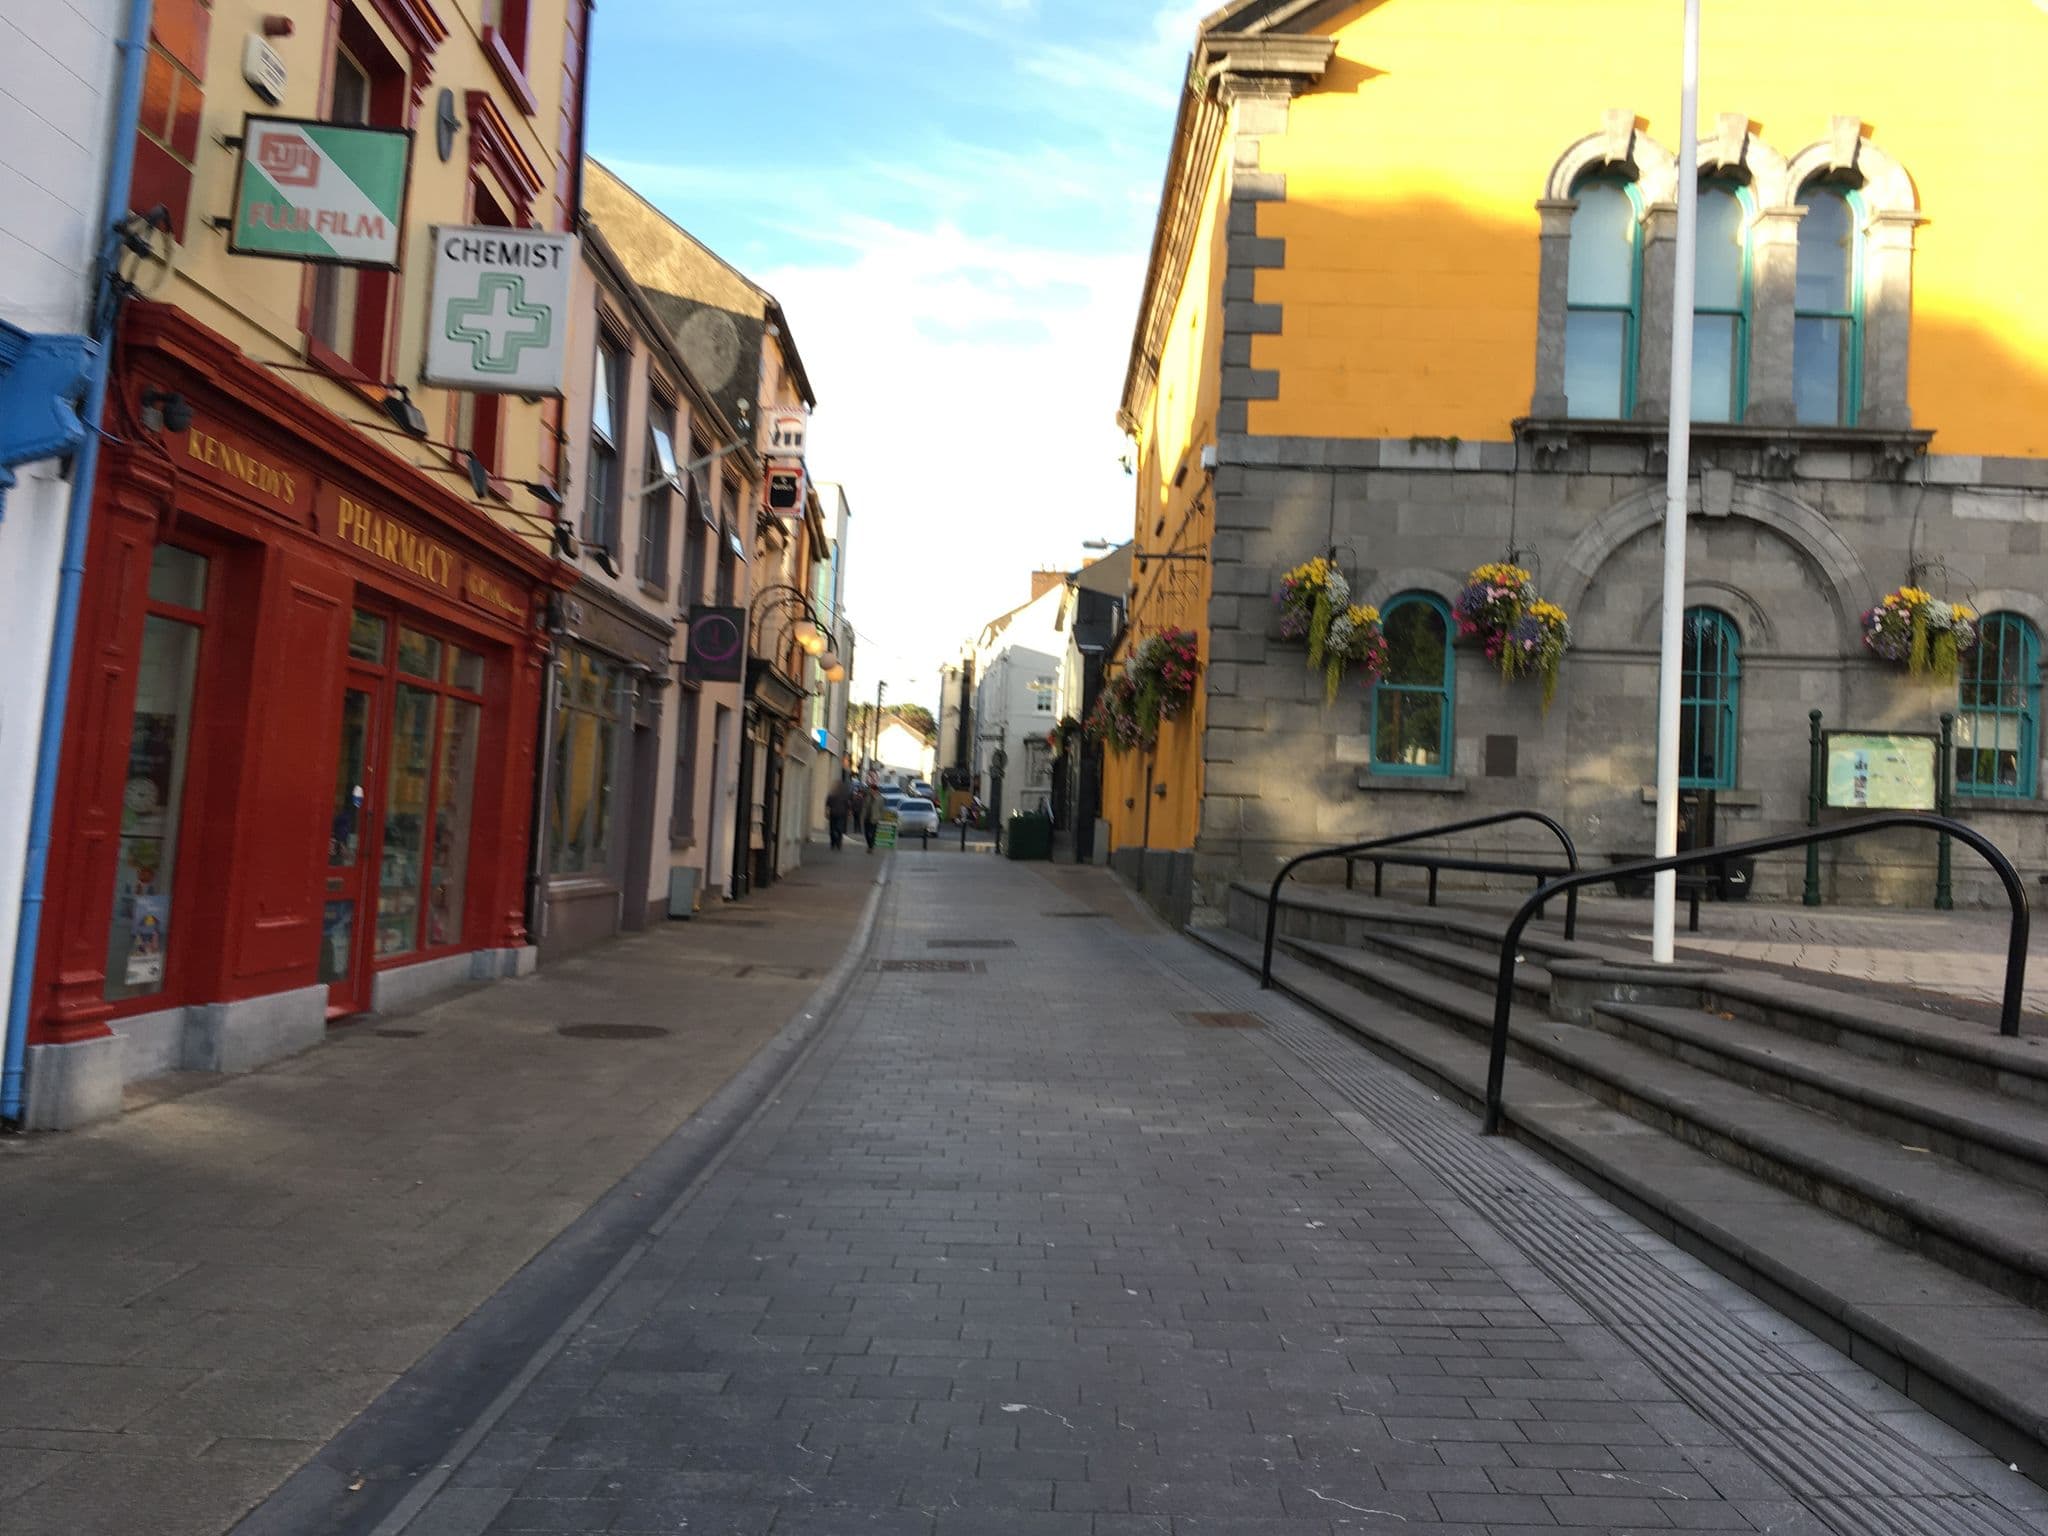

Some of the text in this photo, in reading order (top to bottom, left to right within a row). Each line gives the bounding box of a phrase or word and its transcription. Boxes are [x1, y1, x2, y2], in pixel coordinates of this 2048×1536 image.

[444, 236, 564, 269] CHEMIST
[188, 425, 296, 505] KENNEDY'S
[336, 495, 454, 588] PHARMACY
